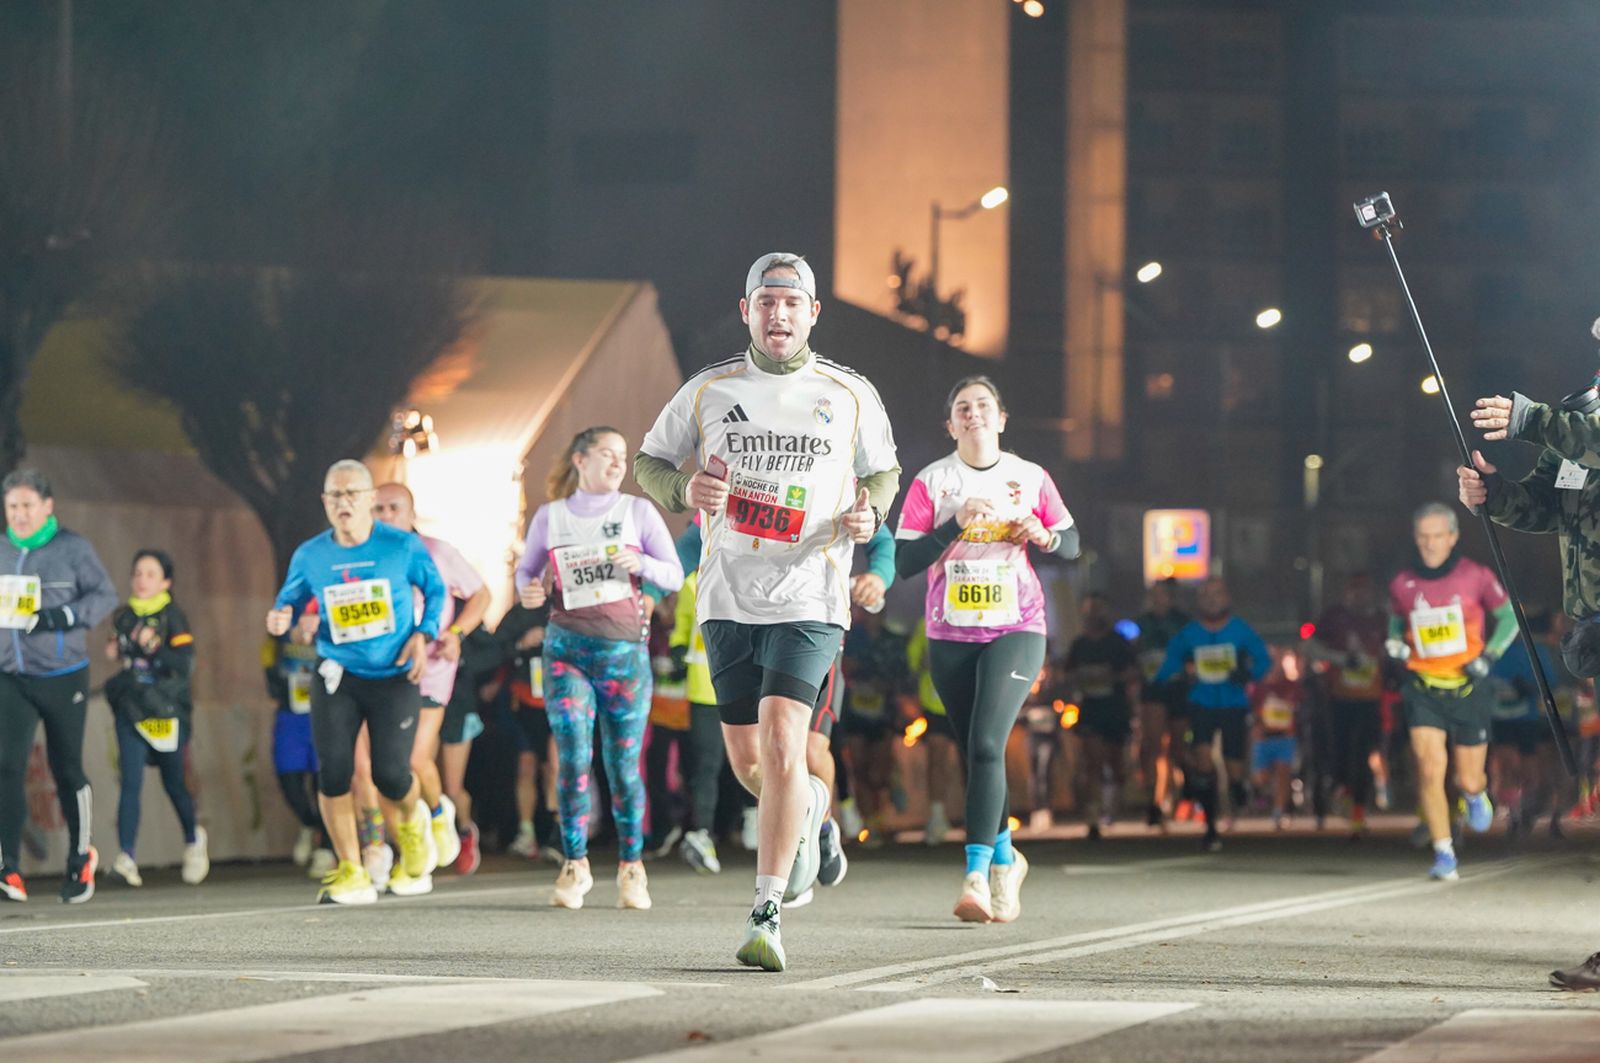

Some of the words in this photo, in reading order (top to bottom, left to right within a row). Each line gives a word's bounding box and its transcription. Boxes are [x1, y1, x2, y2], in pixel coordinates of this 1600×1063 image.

[726, 430, 832, 456] Emirates
[741, 455, 763, 471] FLY
[766, 455, 815, 472] BETTER
[733, 486, 748, 497] SAN
[742, 479, 767, 492] NOCHE
[768, 484, 780, 494] DE
[735, 498, 791, 533] 9736
[573, 563, 616, 586] 3542
[958, 584, 1002, 604] 6618
[339, 601, 381, 623] 9546
